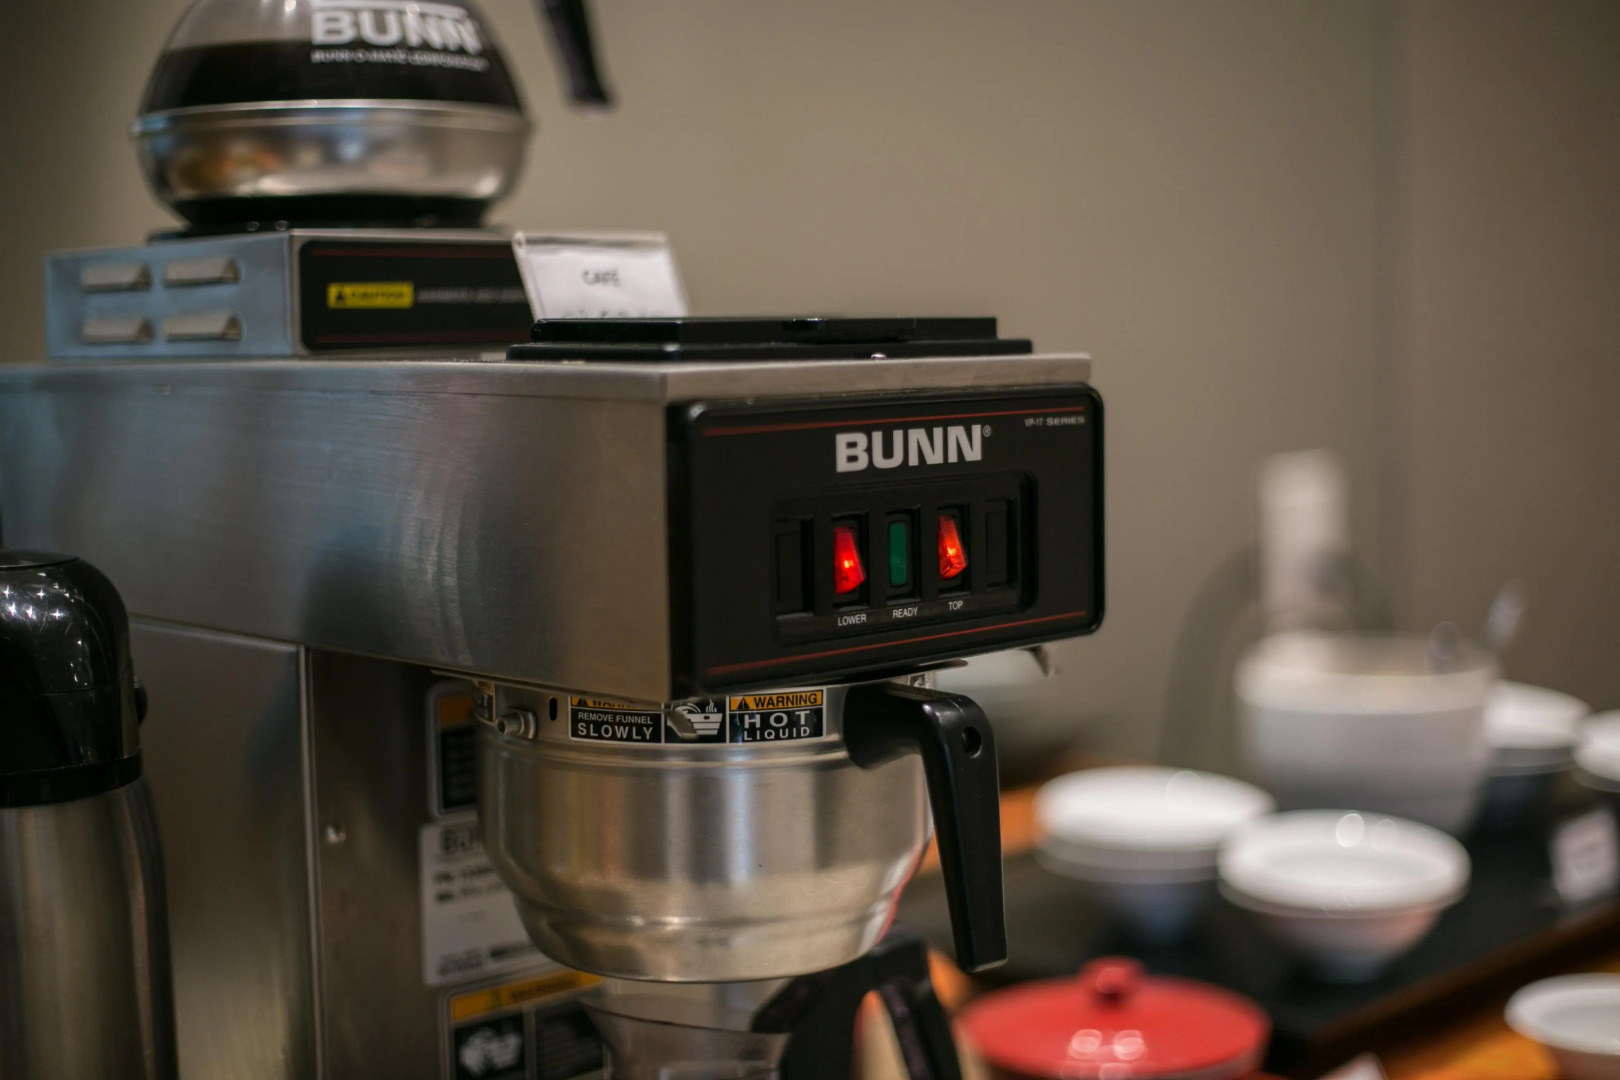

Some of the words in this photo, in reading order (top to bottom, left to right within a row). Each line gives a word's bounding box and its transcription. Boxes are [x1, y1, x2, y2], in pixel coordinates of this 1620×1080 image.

[312, 10, 482, 55] BUNN
[1024, 418, 1044, 428] VP-17
[1046, 415, 1085, 426] SERIES
[948, 600, 963, 611] TOP
[838, 613, 867, 626] LOWER
[892, 607, 918, 619] READY
[753, 693, 817, 708] WARNING
[578, 711, 614, 723] REMOVE
[616, 714, 653, 725] FUNNEL
[744, 710, 810, 729] HOT
[577, 722, 653, 740] SLOWLY
[744, 726, 810, 741] LIQUID
